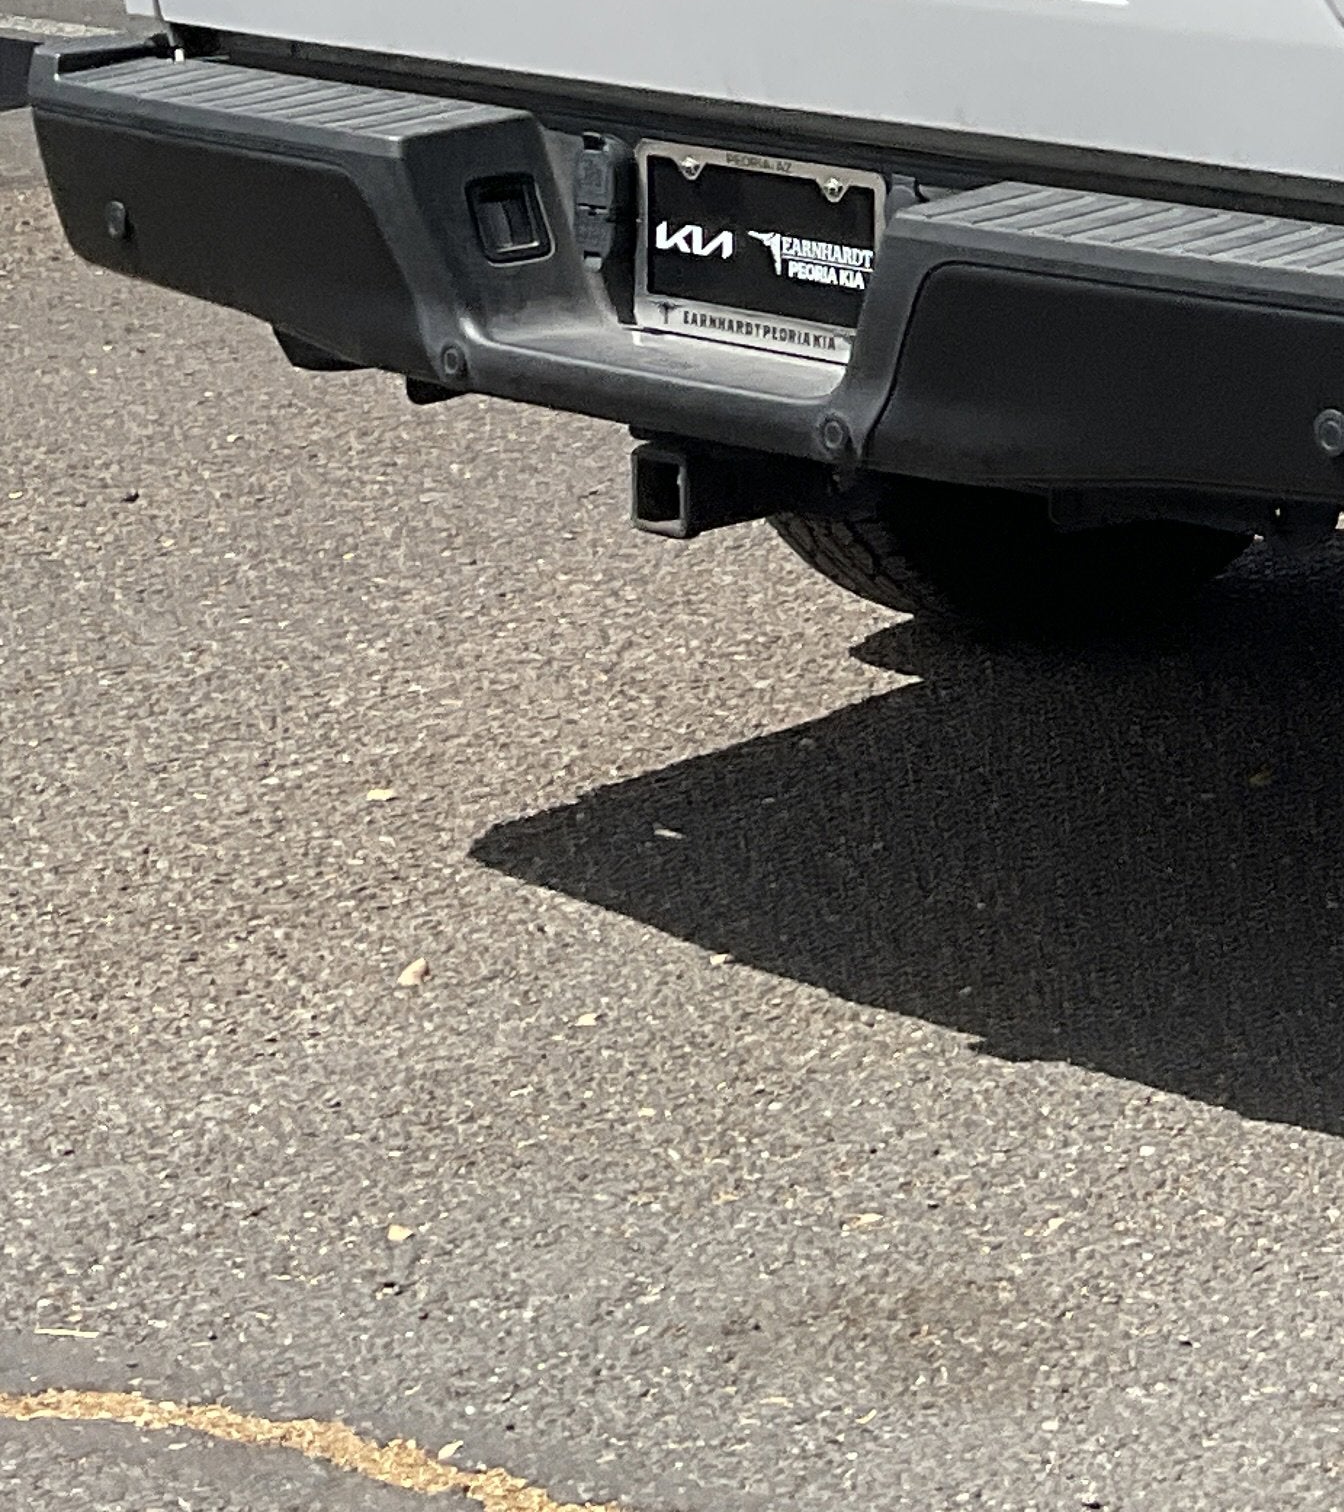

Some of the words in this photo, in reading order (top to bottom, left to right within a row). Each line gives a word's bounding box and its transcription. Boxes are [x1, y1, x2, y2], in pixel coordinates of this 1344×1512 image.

[655, 220, 733, 259] KIA
[781, 235, 874, 268] EARNHARDT
[787, 260, 838, 286] PEORIA
[838, 269, 865, 290] KIA
